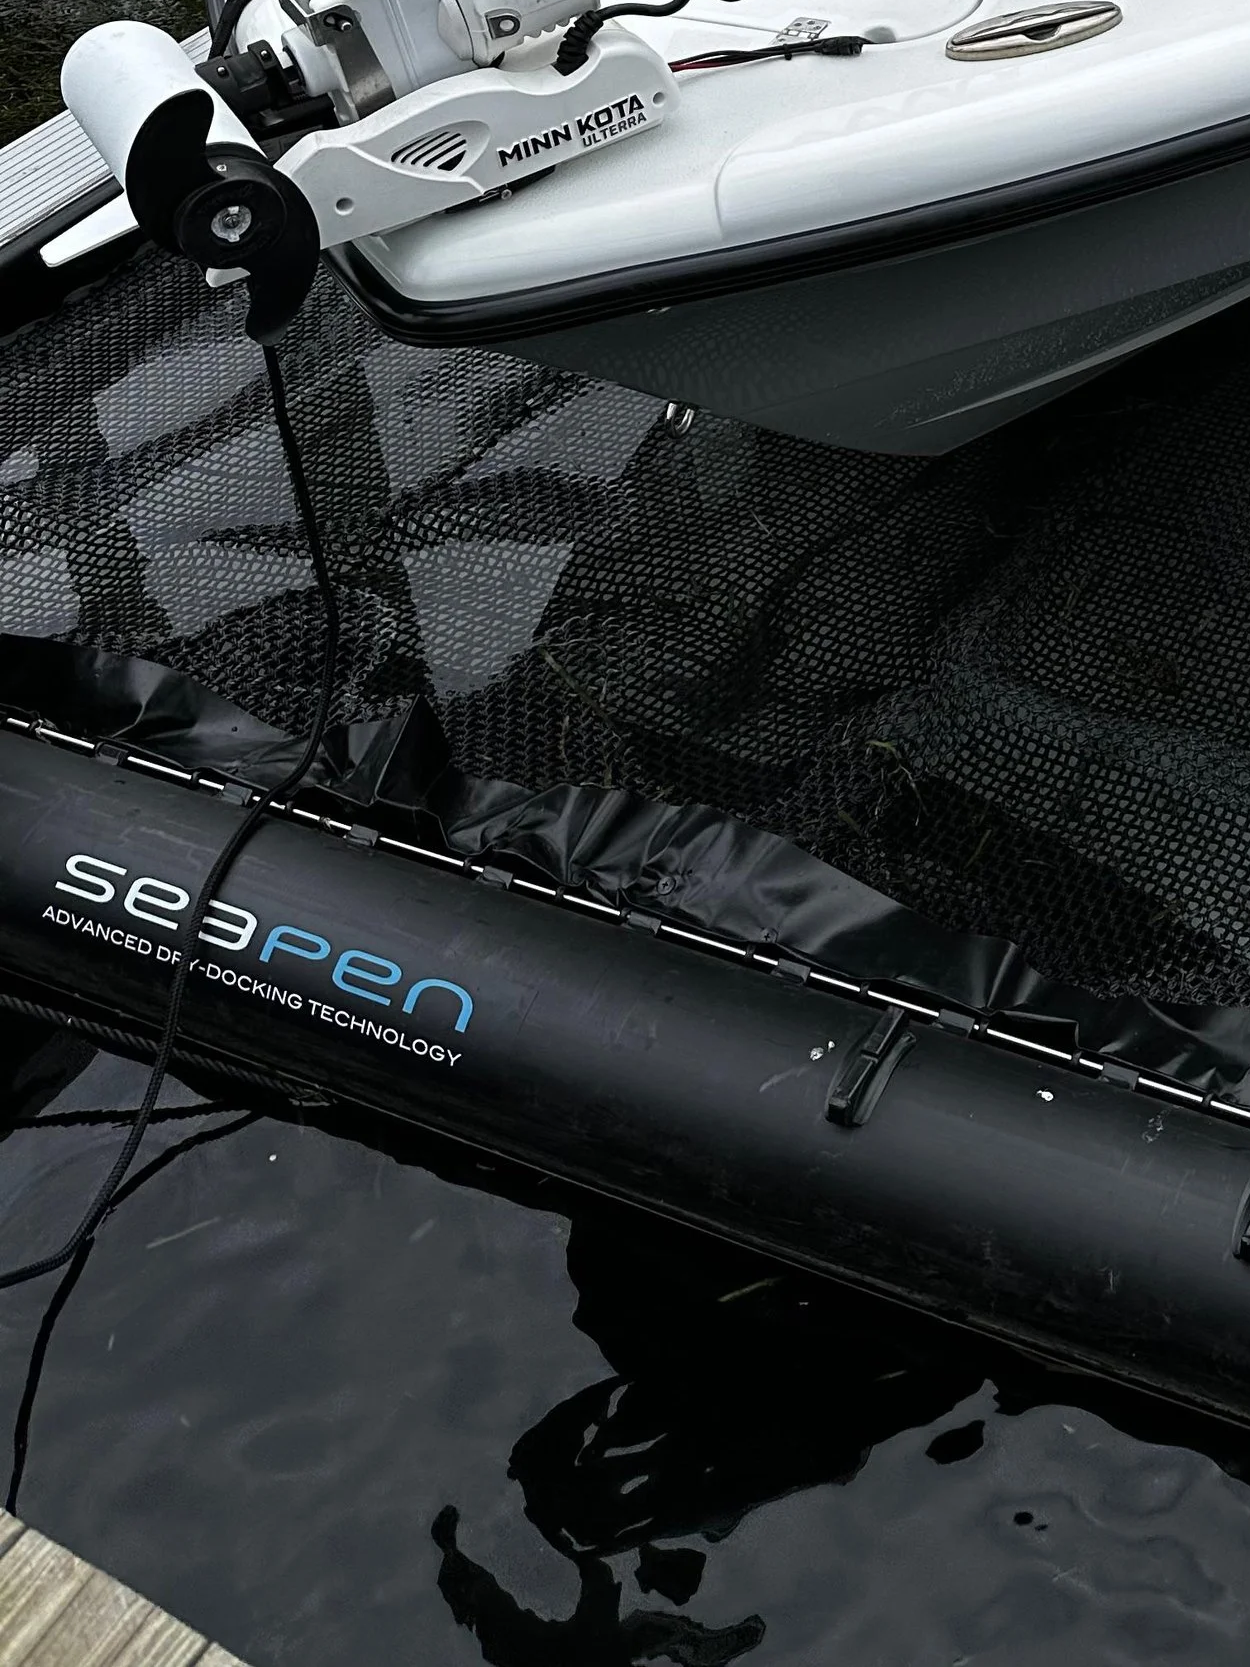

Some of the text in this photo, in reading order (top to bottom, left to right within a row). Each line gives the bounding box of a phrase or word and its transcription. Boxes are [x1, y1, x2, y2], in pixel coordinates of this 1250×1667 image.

[497, 94, 645, 167] MINN KOTA
[581, 112, 648, 148] ULTERRA
[41, 905, 152, 955] ADVANCED
[308, 998, 462, 1067] TECHNOLOGY
